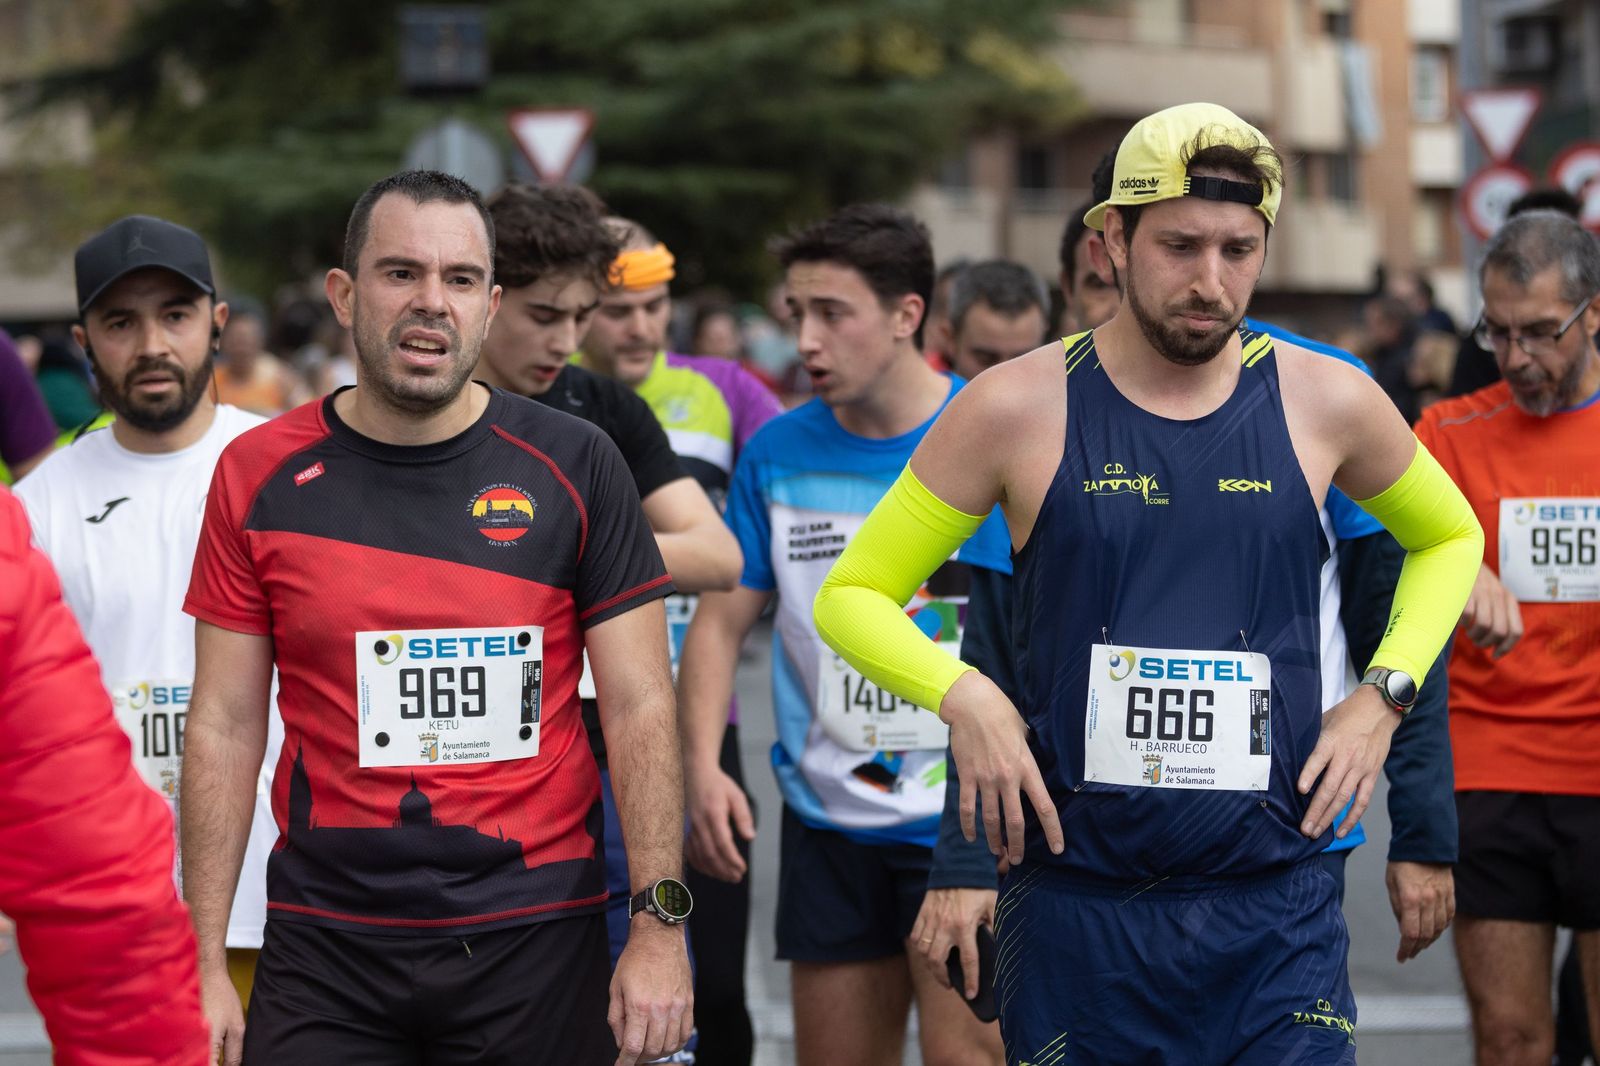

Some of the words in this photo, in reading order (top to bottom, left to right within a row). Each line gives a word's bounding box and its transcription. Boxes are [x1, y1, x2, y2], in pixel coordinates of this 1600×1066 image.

[1119, 177, 1147, 189] adidas
[1104, 463, 1127, 475] C.D.
[1217, 479, 1272, 493] KON
[1540, 505, 1600, 521] SET
[1532, 527, 1596, 566] 956
[408, 636, 527, 659] SETEL
[1139, 657, 1253, 682] SETEL
[400, 666, 487, 720] 969
[1126, 686, 1215, 742] 666
[428, 720, 460, 731] KETU
[442, 741, 491, 751] Ayuntamiento
[1146, 742, 1208, 754] BARRUECO
[442, 753, 451, 761] de
[453, 751, 490, 761] Salamanca
[1165, 764, 1215, 776] Ayuntamiento
[1164, 775, 1174, 784] de
[1175, 775, 1215, 785] Salamanca
[1317, 998, 1334, 1012] C.D.
